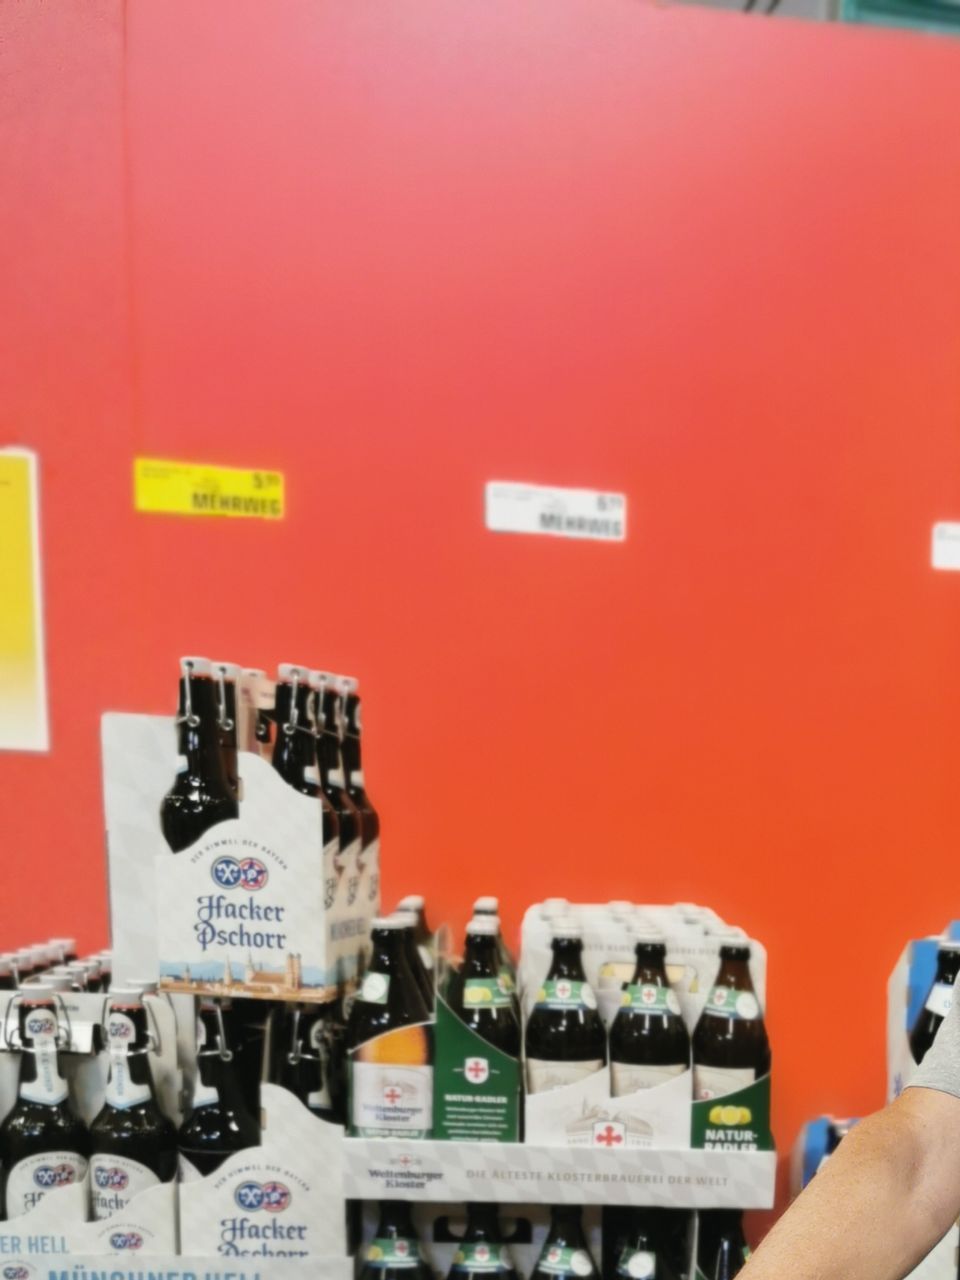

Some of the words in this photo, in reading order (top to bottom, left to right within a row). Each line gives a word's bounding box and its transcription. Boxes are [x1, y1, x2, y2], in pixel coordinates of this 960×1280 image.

[193, 493, 281, 516] MEHRWEG
[197, 895, 285, 922] Hacker
[194, 921, 286, 952] Pschorr
[705, 1129, 758, 1142] NATUR-
[221, 1216, 308, 1240] Hacker
[28, 1236, 70, 1254] HELL
